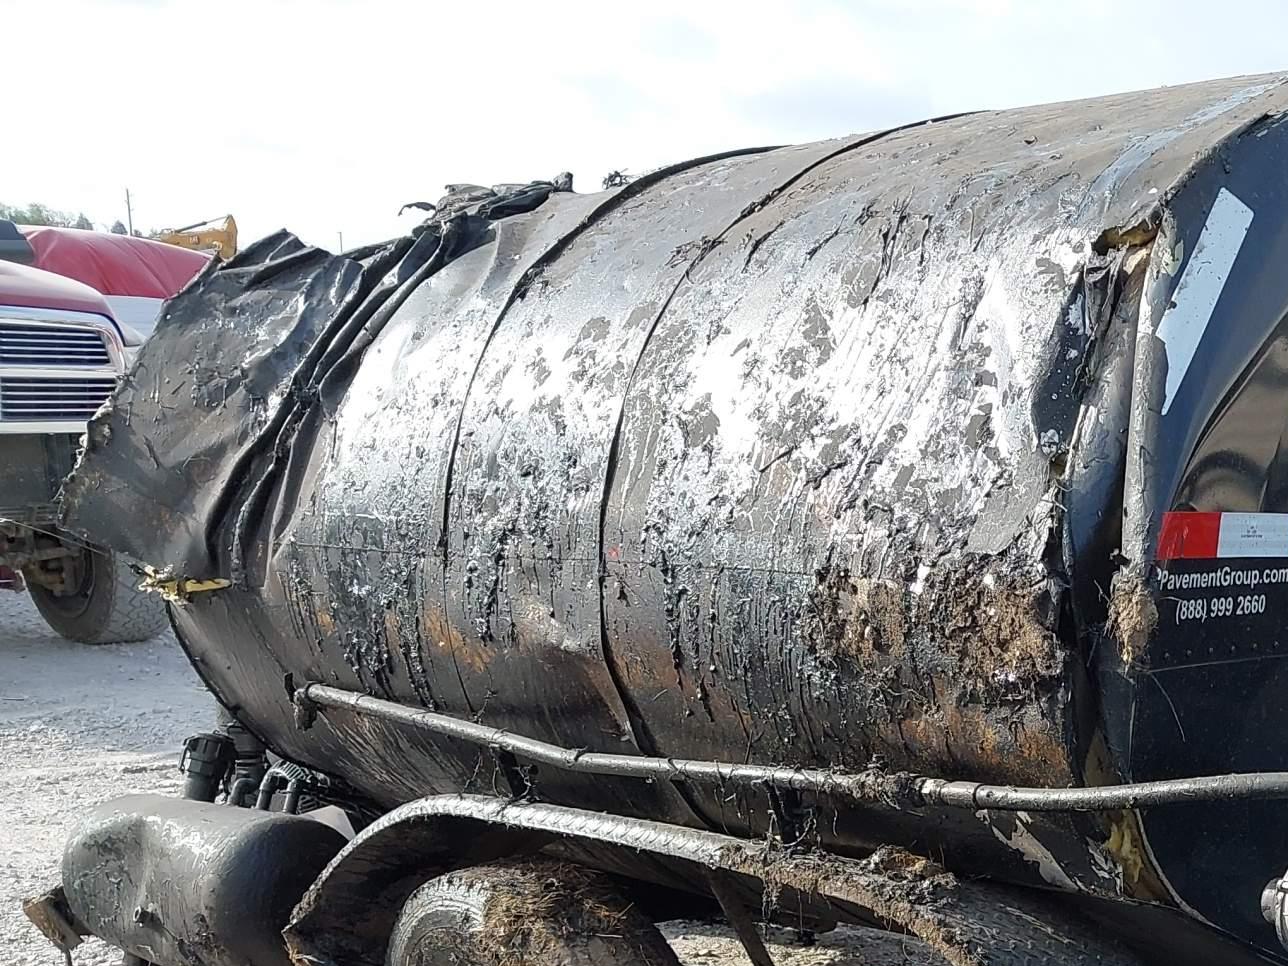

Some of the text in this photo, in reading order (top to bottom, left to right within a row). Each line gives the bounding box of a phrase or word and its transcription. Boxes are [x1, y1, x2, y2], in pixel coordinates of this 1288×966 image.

[1175, 594, 1266, 625] (888) 999 2660
